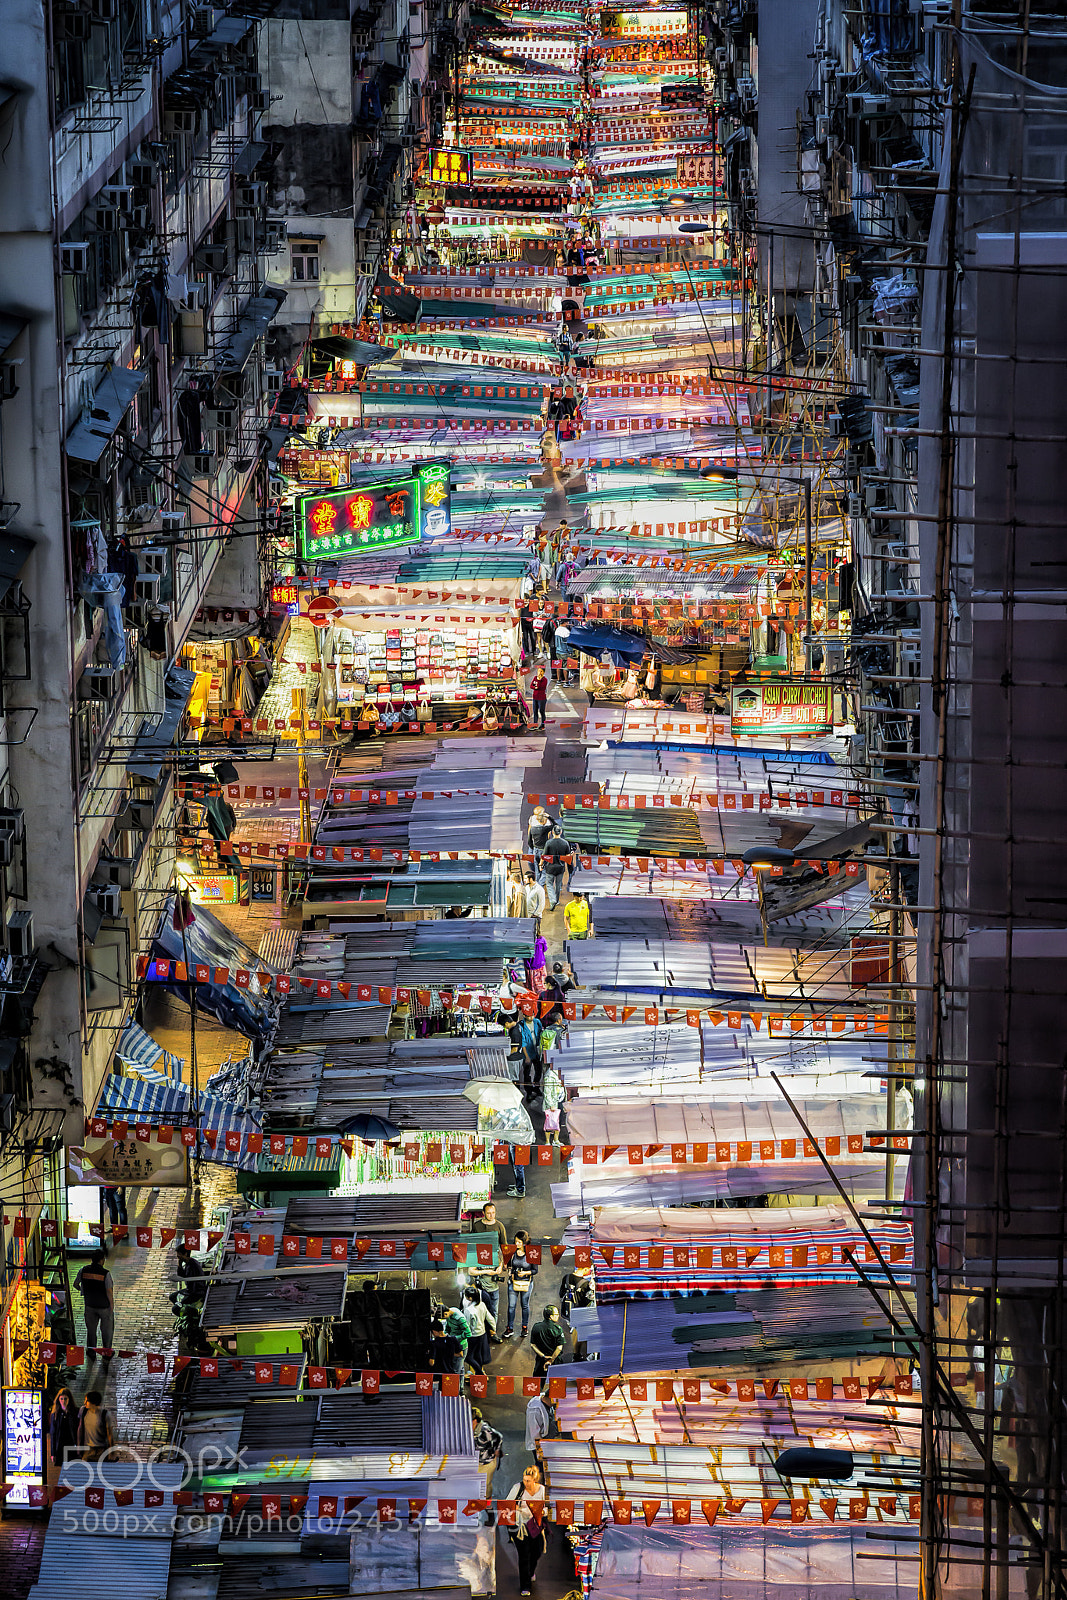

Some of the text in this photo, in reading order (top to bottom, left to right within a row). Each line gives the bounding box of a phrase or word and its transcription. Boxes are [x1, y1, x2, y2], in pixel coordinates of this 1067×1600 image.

[763, 686, 826, 705] ASIAN CURRY KITCHEN
[763, 706, 827, 723] 亞星咖喱
[253, 870, 273, 882] DVD
[253, 883, 272, 892] $10
[16, 1434, 31, 1443] AV
